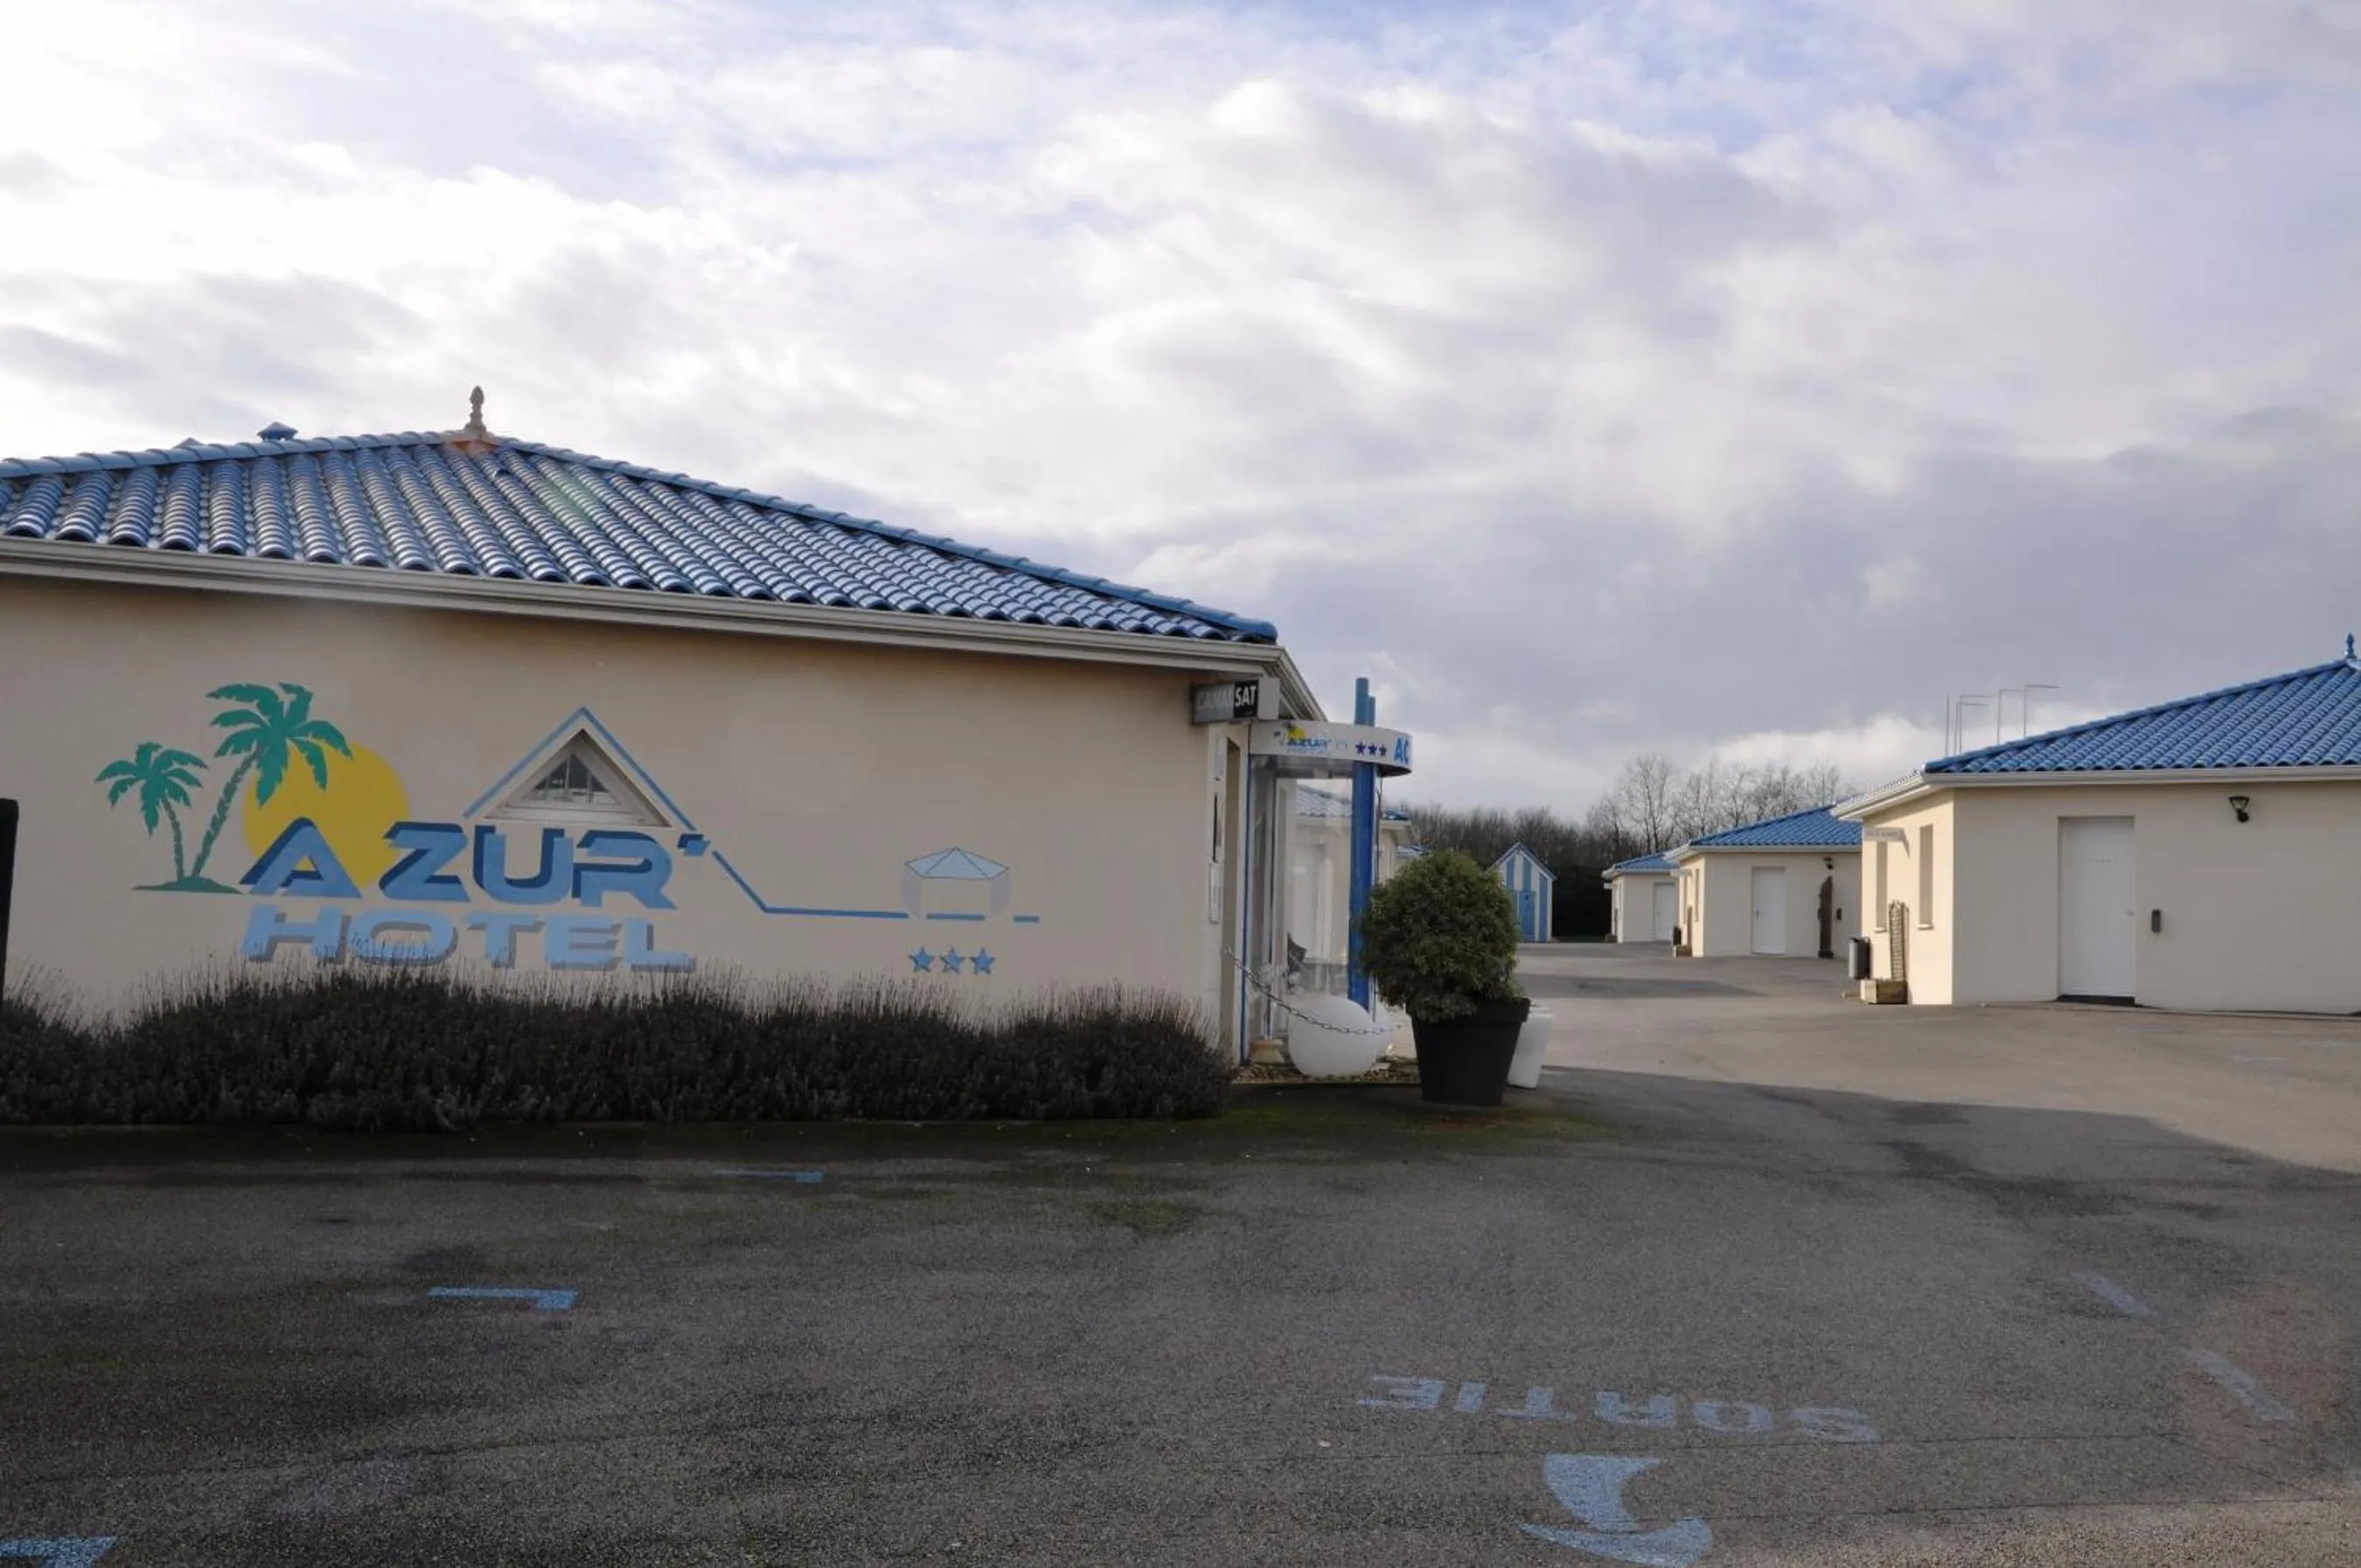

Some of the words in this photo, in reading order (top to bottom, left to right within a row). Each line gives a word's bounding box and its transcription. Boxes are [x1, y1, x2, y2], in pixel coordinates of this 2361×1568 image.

[1235, 686, 1257, 707] SAT
[240, 904, 696, 972] HOTEL
[1357, 1376, 1880, 1443] SORTIE
